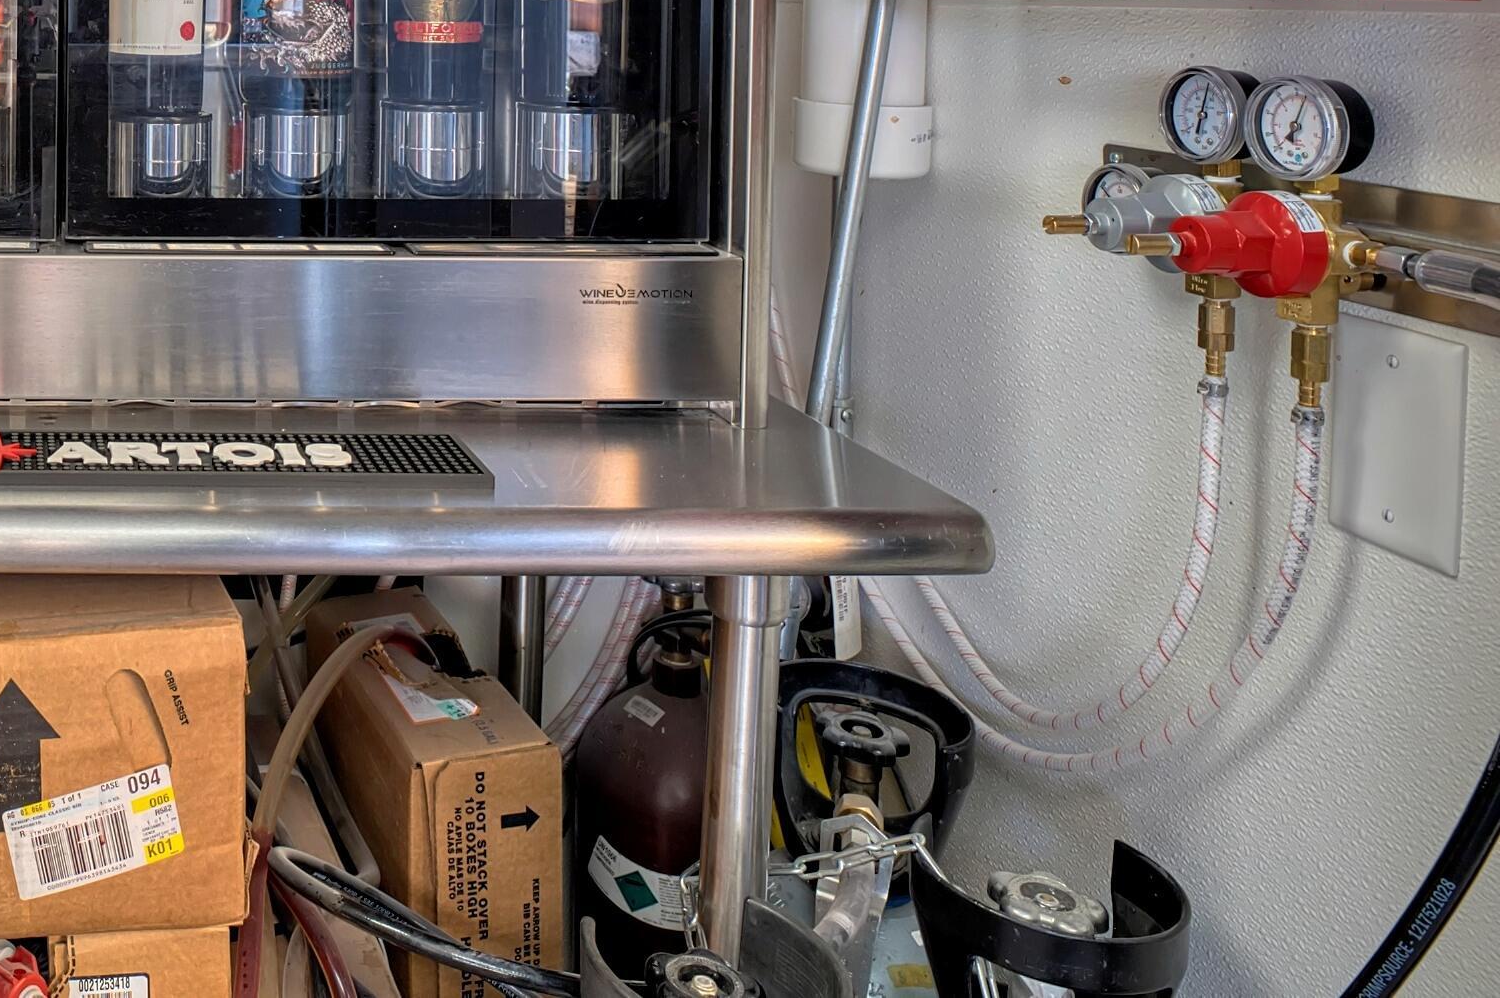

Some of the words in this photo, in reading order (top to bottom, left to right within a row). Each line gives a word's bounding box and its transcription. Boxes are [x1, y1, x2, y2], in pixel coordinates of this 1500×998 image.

[47, 439, 353, 467] ARTOIS
[163, 669, 176, 693] GRIP
[172, 694, 190, 727] ASSIST
[100, 781, 119, 793] CASE
[127, 768, 161, 794] 094
[475, 771, 485, 794] DO
[67, 794, 75, 803] of
[464, 797, 475, 814] 10
[454, 807, 462, 821] NO
[475, 800, 487, 833] NOT
[19, 830, 26, 838] R
[447, 821, 455, 855] CAJAS
[455, 825, 463, 854] APILE
[147, 840, 173, 859] K01
[465, 821, 477, 874] BOXES
[447, 857, 455, 871] DE
[456, 857, 464, 879] MAS
[476, 840, 488, 892] STACK
[457, 881, 464, 895] DE
[532, 878, 540, 904] KEEP
[457, 900, 464, 912] 10
[467, 881, 478, 919] HIGH
[1408, 877, 1457, 942] 1217521028
[478, 900, 489, 941] OVER
[524, 946, 531, 959] BE
[533, 945, 540, 960] UP
[78, 977, 131, 991] 0021253418
